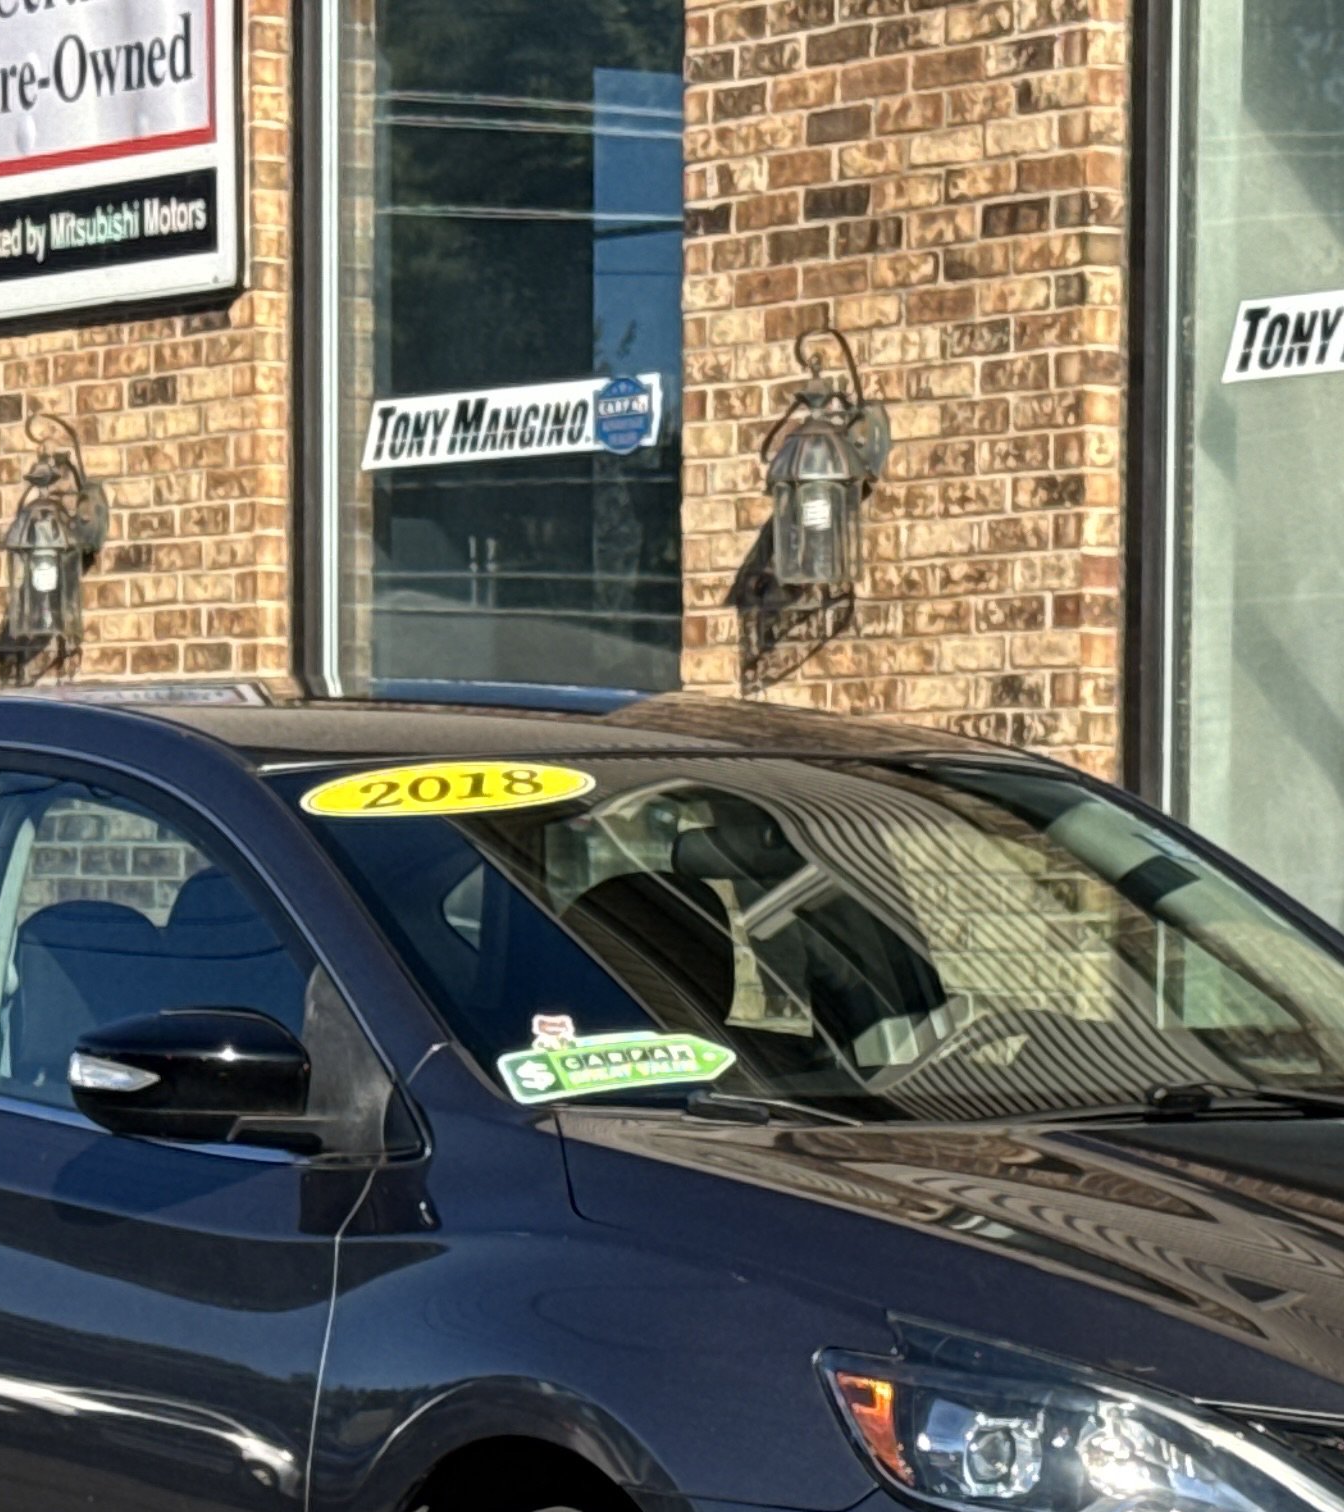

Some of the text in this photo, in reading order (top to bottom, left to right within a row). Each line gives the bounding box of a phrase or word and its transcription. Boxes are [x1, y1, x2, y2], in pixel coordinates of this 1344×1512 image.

[25, 215, 46, 264] by
[50, 200, 141, 250] Mitsubishi
[143, 197, 206, 238] Motors
[373, 405, 450, 461] TONY
[359, 769, 544, 810] 2018
